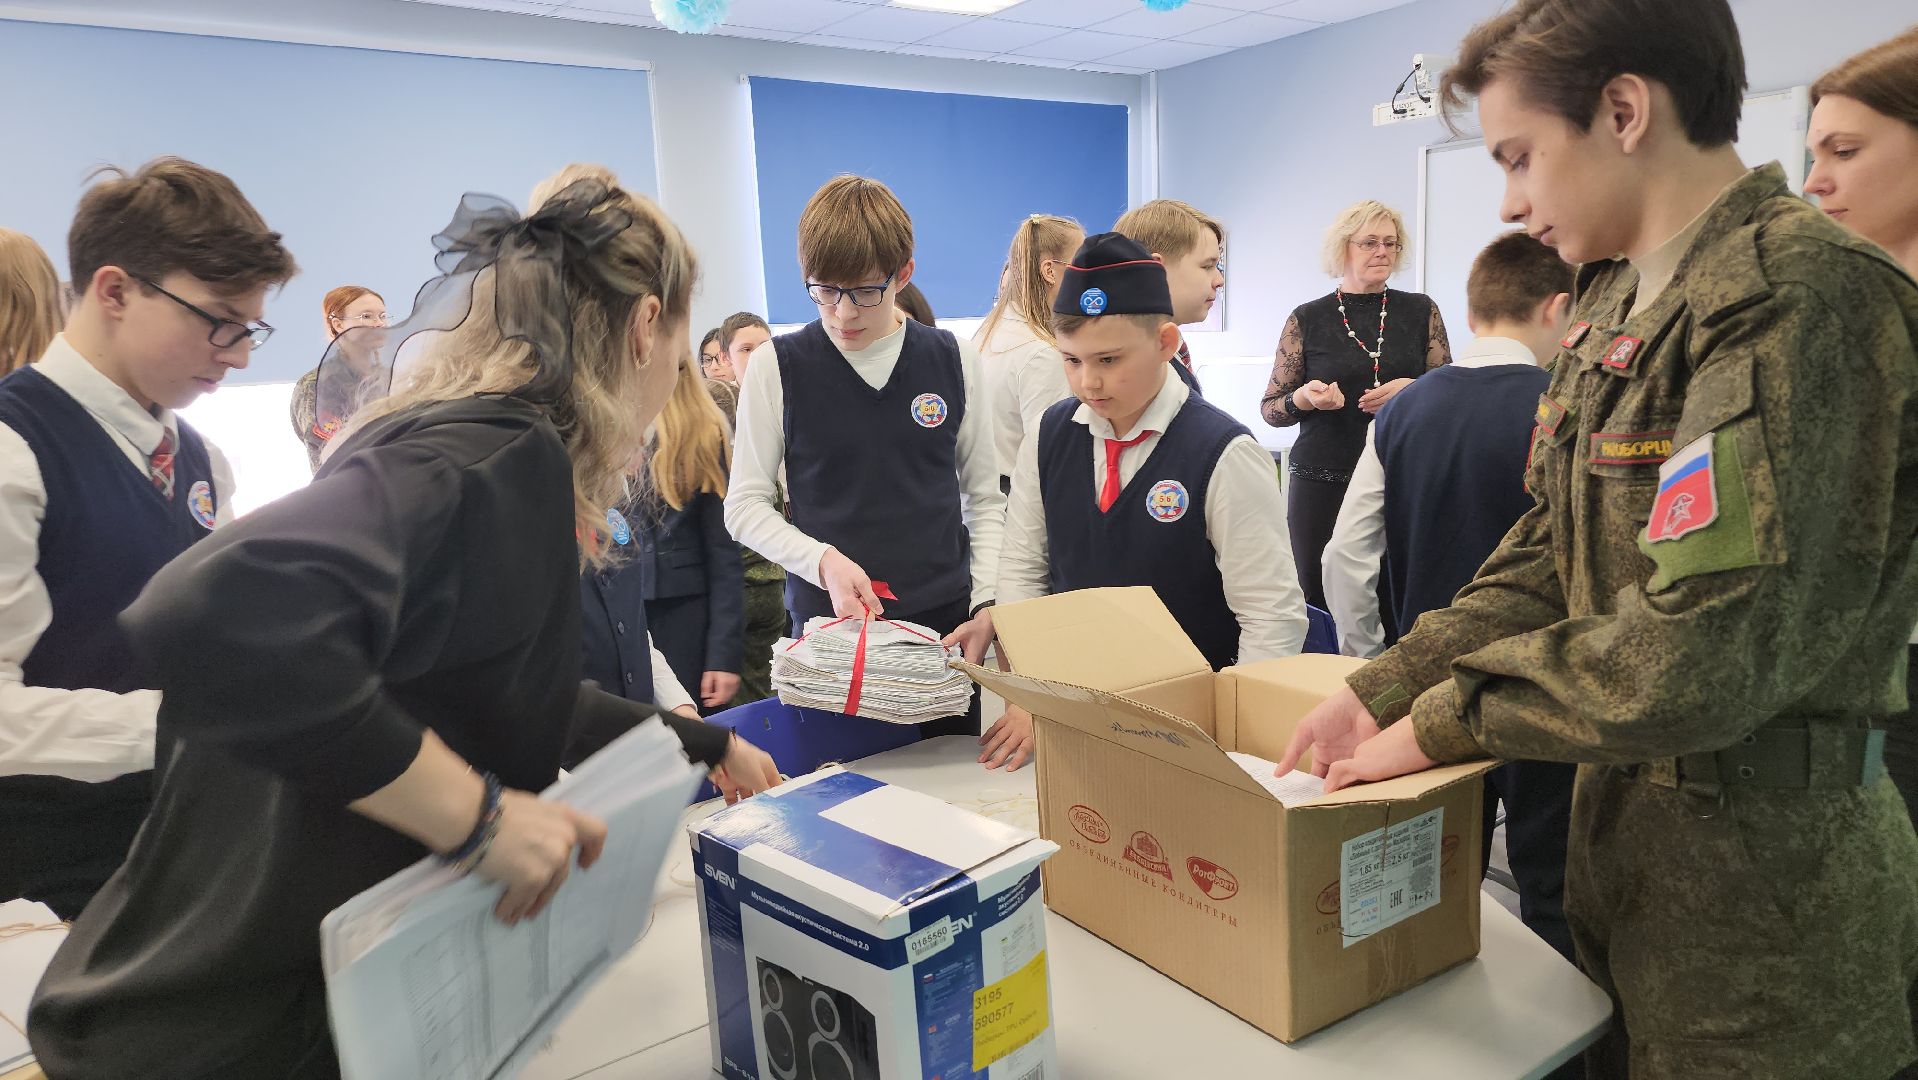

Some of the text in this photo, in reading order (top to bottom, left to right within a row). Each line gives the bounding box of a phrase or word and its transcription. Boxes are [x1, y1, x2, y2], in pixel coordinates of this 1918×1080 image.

[704, 863, 736, 890] SVEN
[1162, 886, 1238, 928] КОНДИТЕРЫ
[951, 914, 974, 937] EN
[857, 940, 870, 951] 2.0
[975, 987, 1002, 1010] 3195
